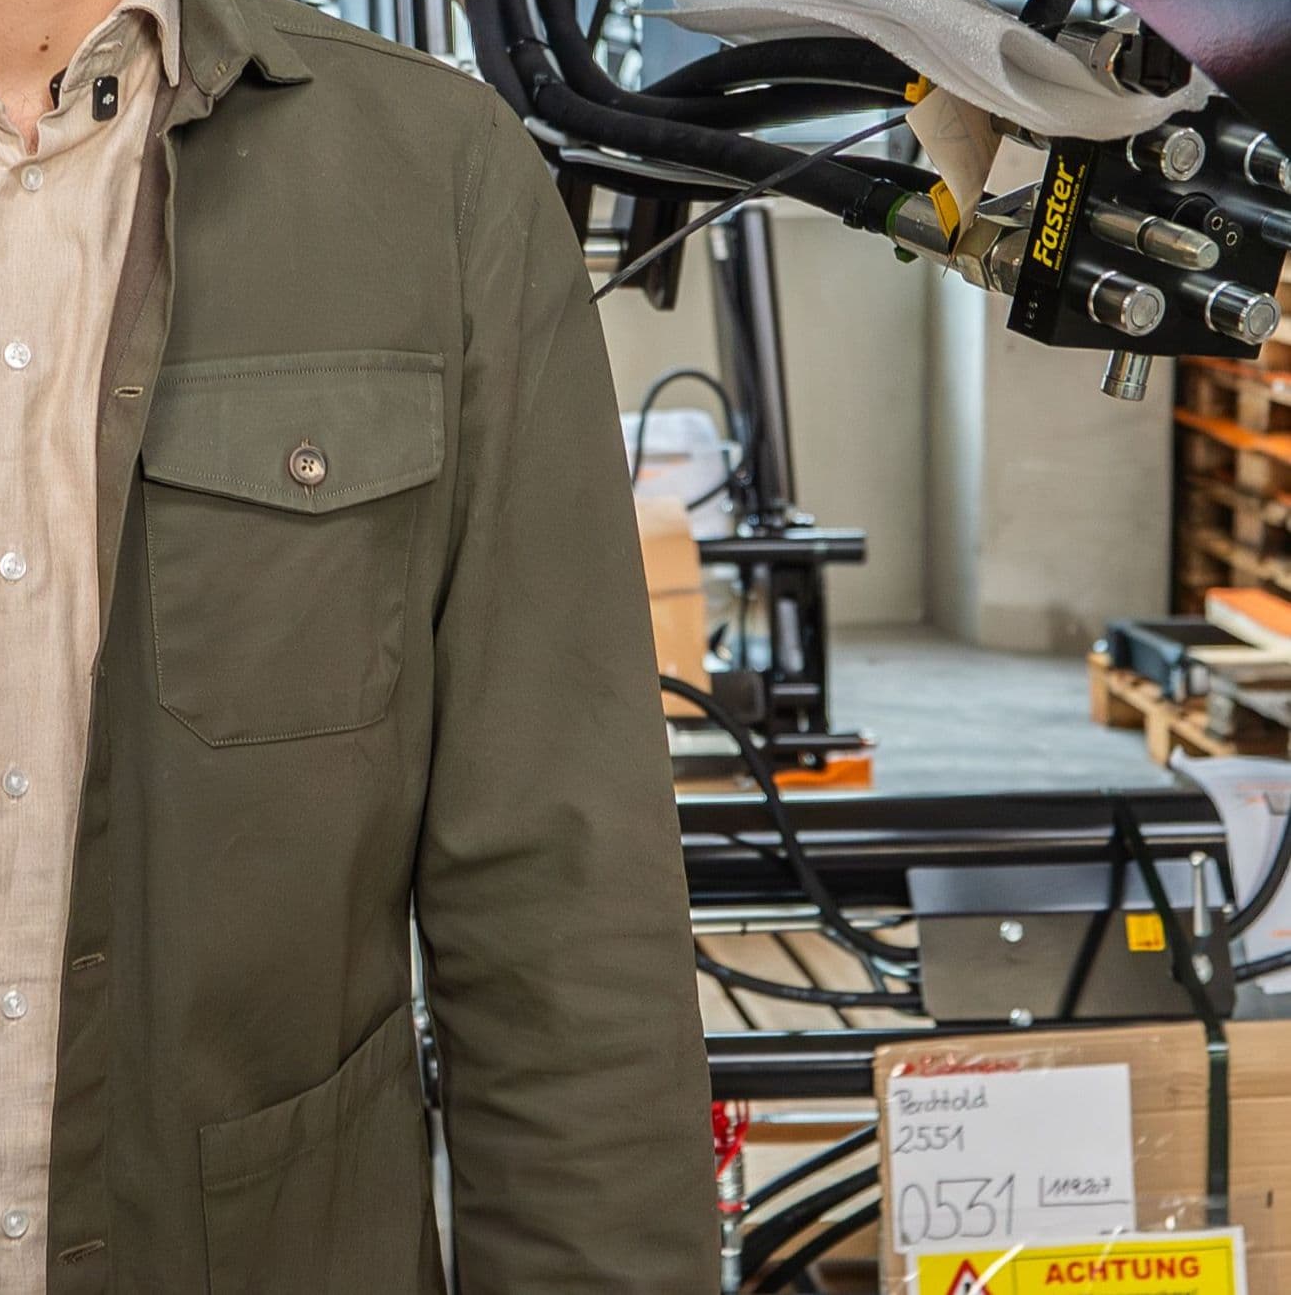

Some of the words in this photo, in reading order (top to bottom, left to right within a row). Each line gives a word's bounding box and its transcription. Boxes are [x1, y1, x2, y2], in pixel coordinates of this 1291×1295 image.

[1032, 159, 1074, 268] Faster
[892, 1124, 965, 1155] 2551
[898, 1174, 1016, 1247] 0531
[1045, 1257, 1201, 1285] ACHTUNG
